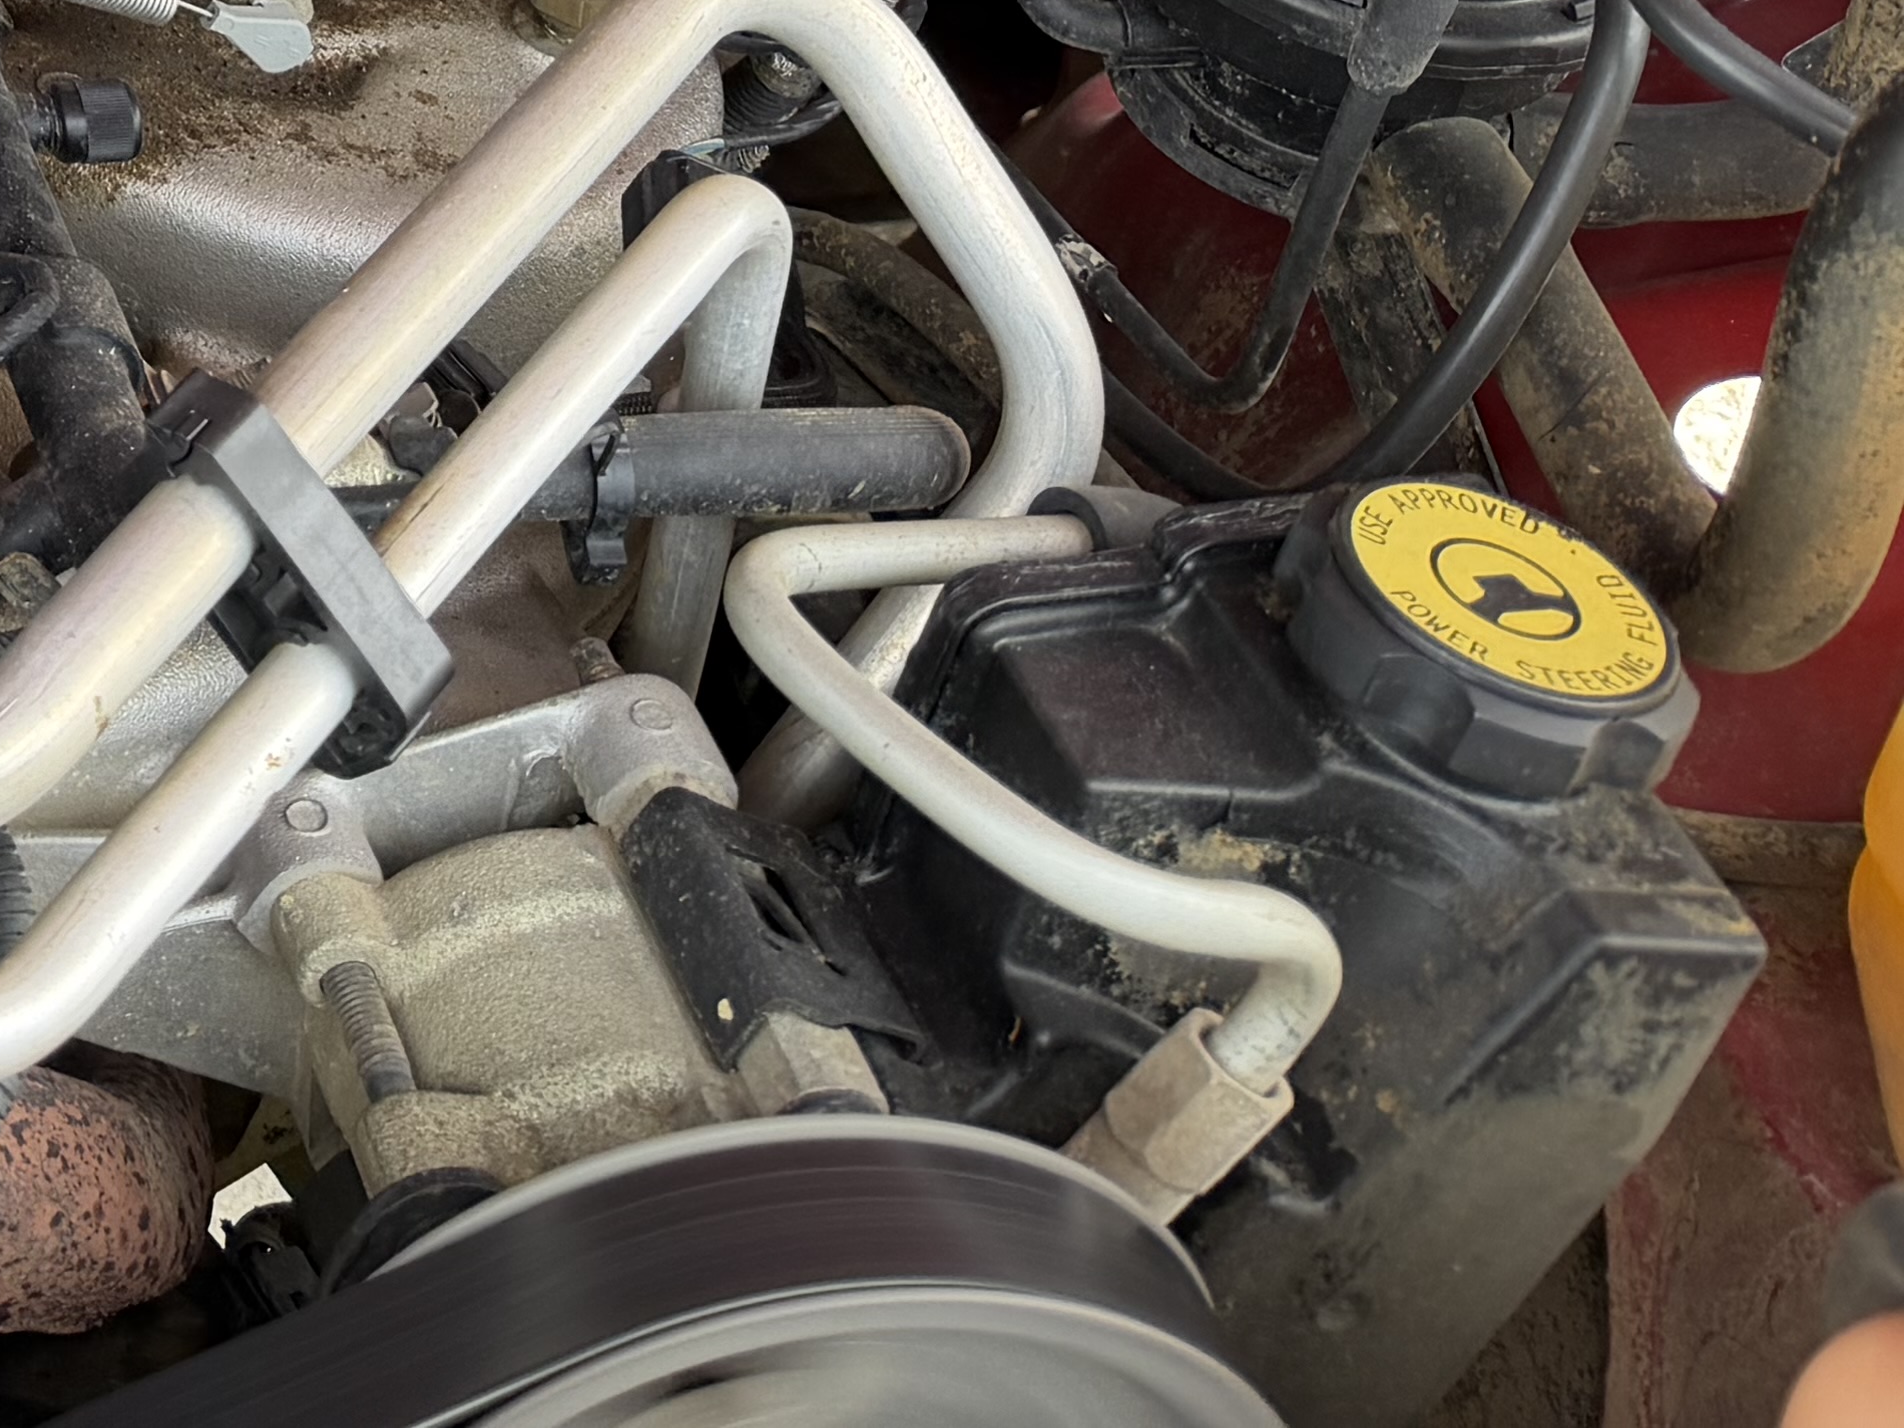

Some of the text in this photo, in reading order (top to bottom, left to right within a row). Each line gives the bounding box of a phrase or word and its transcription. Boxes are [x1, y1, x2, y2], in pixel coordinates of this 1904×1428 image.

[1357, 486, 1542, 547] USE APPROVED
[1389, 573, 1660, 693] POWER STEERING FLUID
